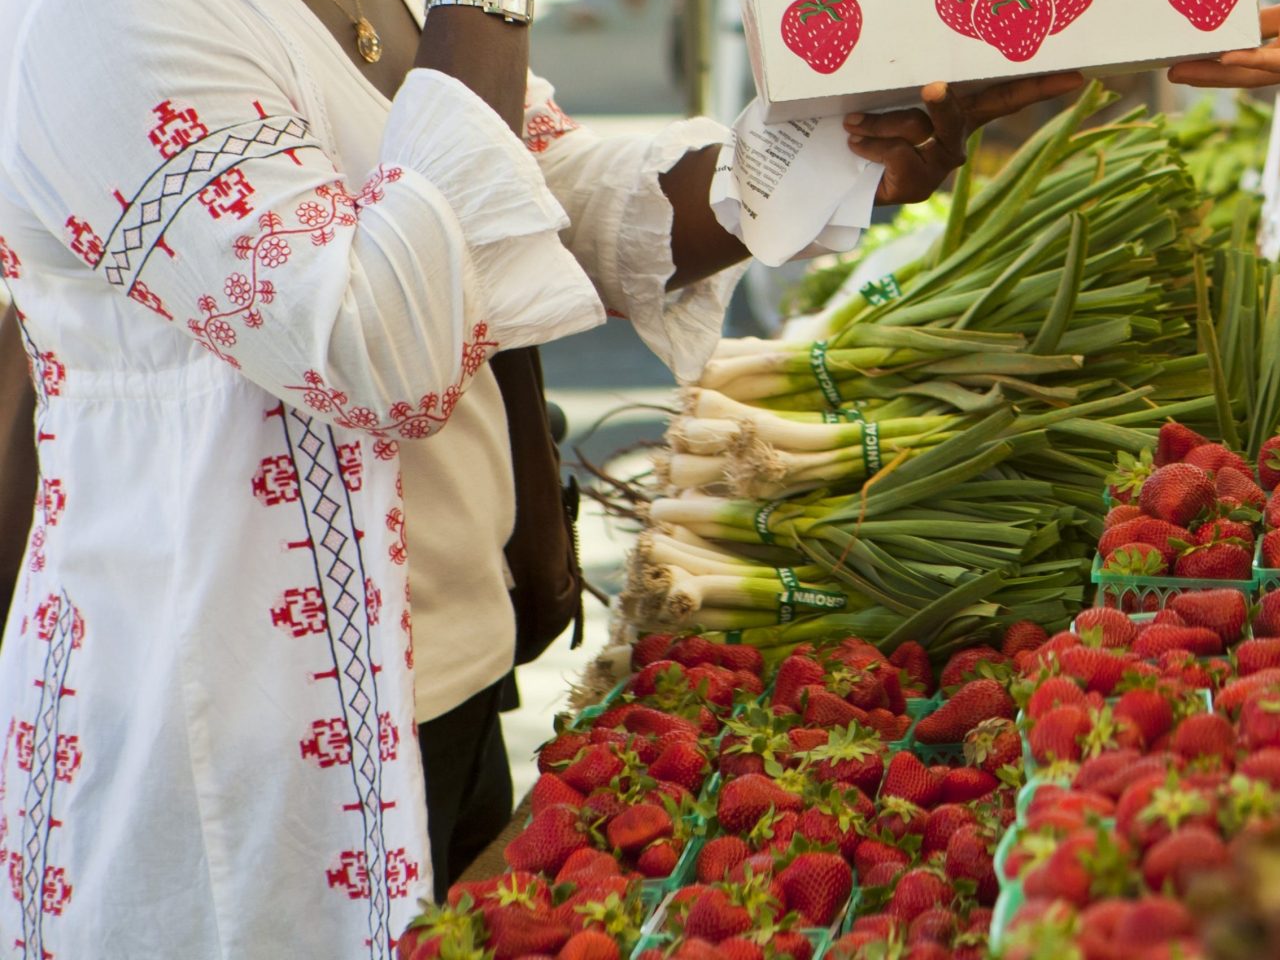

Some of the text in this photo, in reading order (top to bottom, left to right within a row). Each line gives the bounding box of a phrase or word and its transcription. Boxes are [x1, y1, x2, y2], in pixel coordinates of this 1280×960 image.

[765, 149, 791, 166] Tuesday
[746, 181, 770, 198] Monday
[793, 591, 845, 608] GROWN
